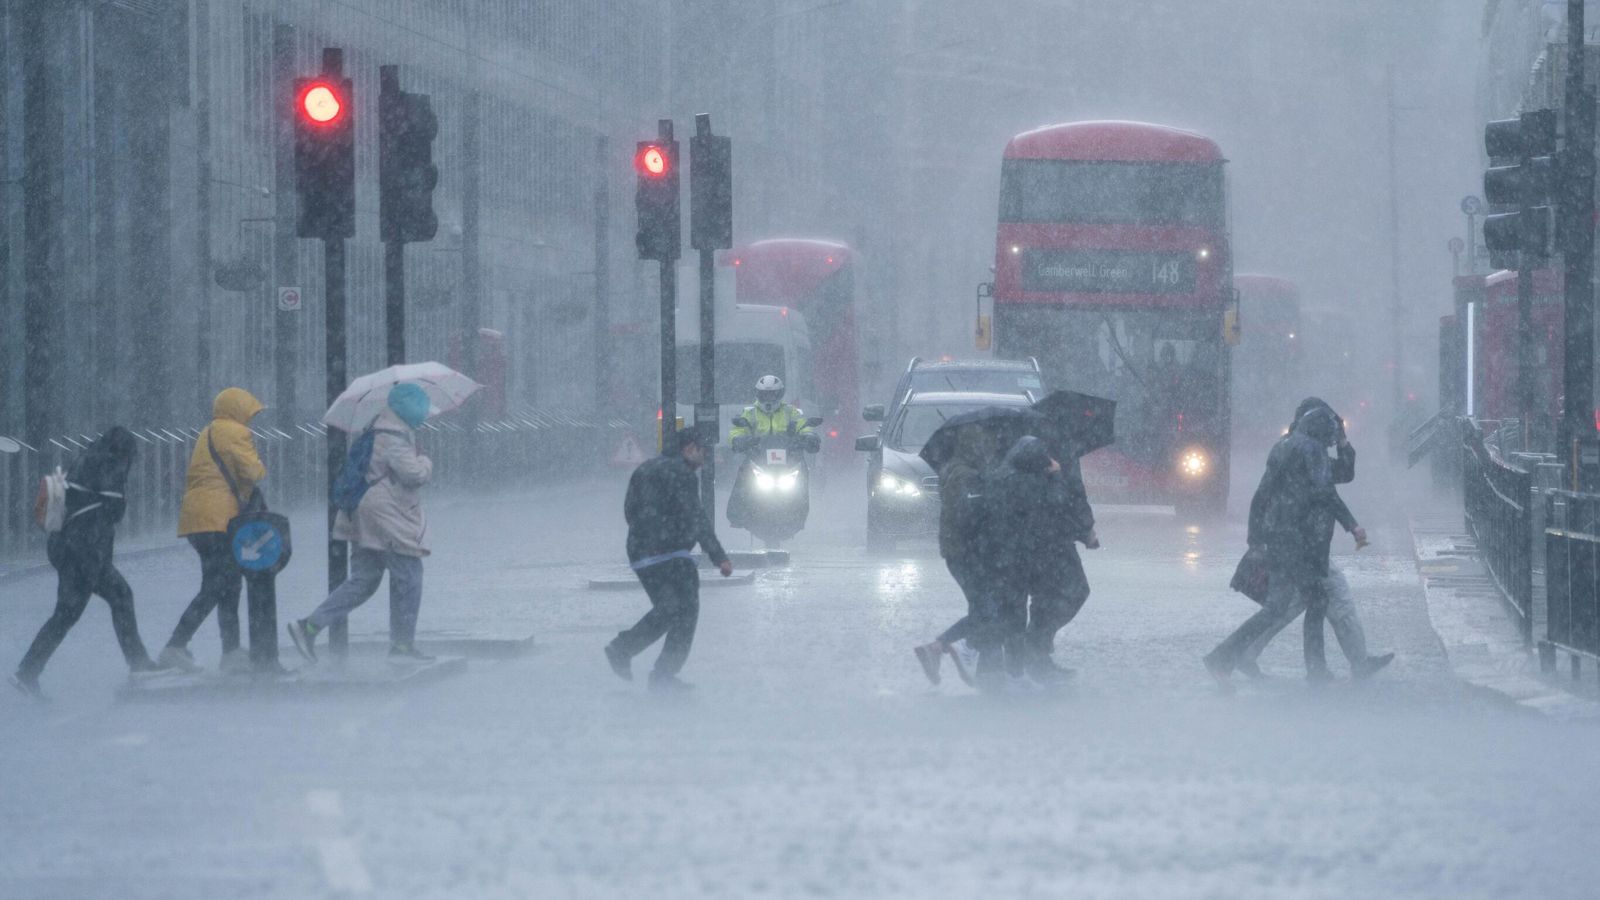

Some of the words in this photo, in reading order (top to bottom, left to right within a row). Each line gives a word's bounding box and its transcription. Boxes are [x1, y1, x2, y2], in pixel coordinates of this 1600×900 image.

[1038, 263, 1096, 278] Camberwell
[1100, 264, 1128, 279] Green
[1152, 259, 1180, 284] 148
[771, 451, 782, 461] L
